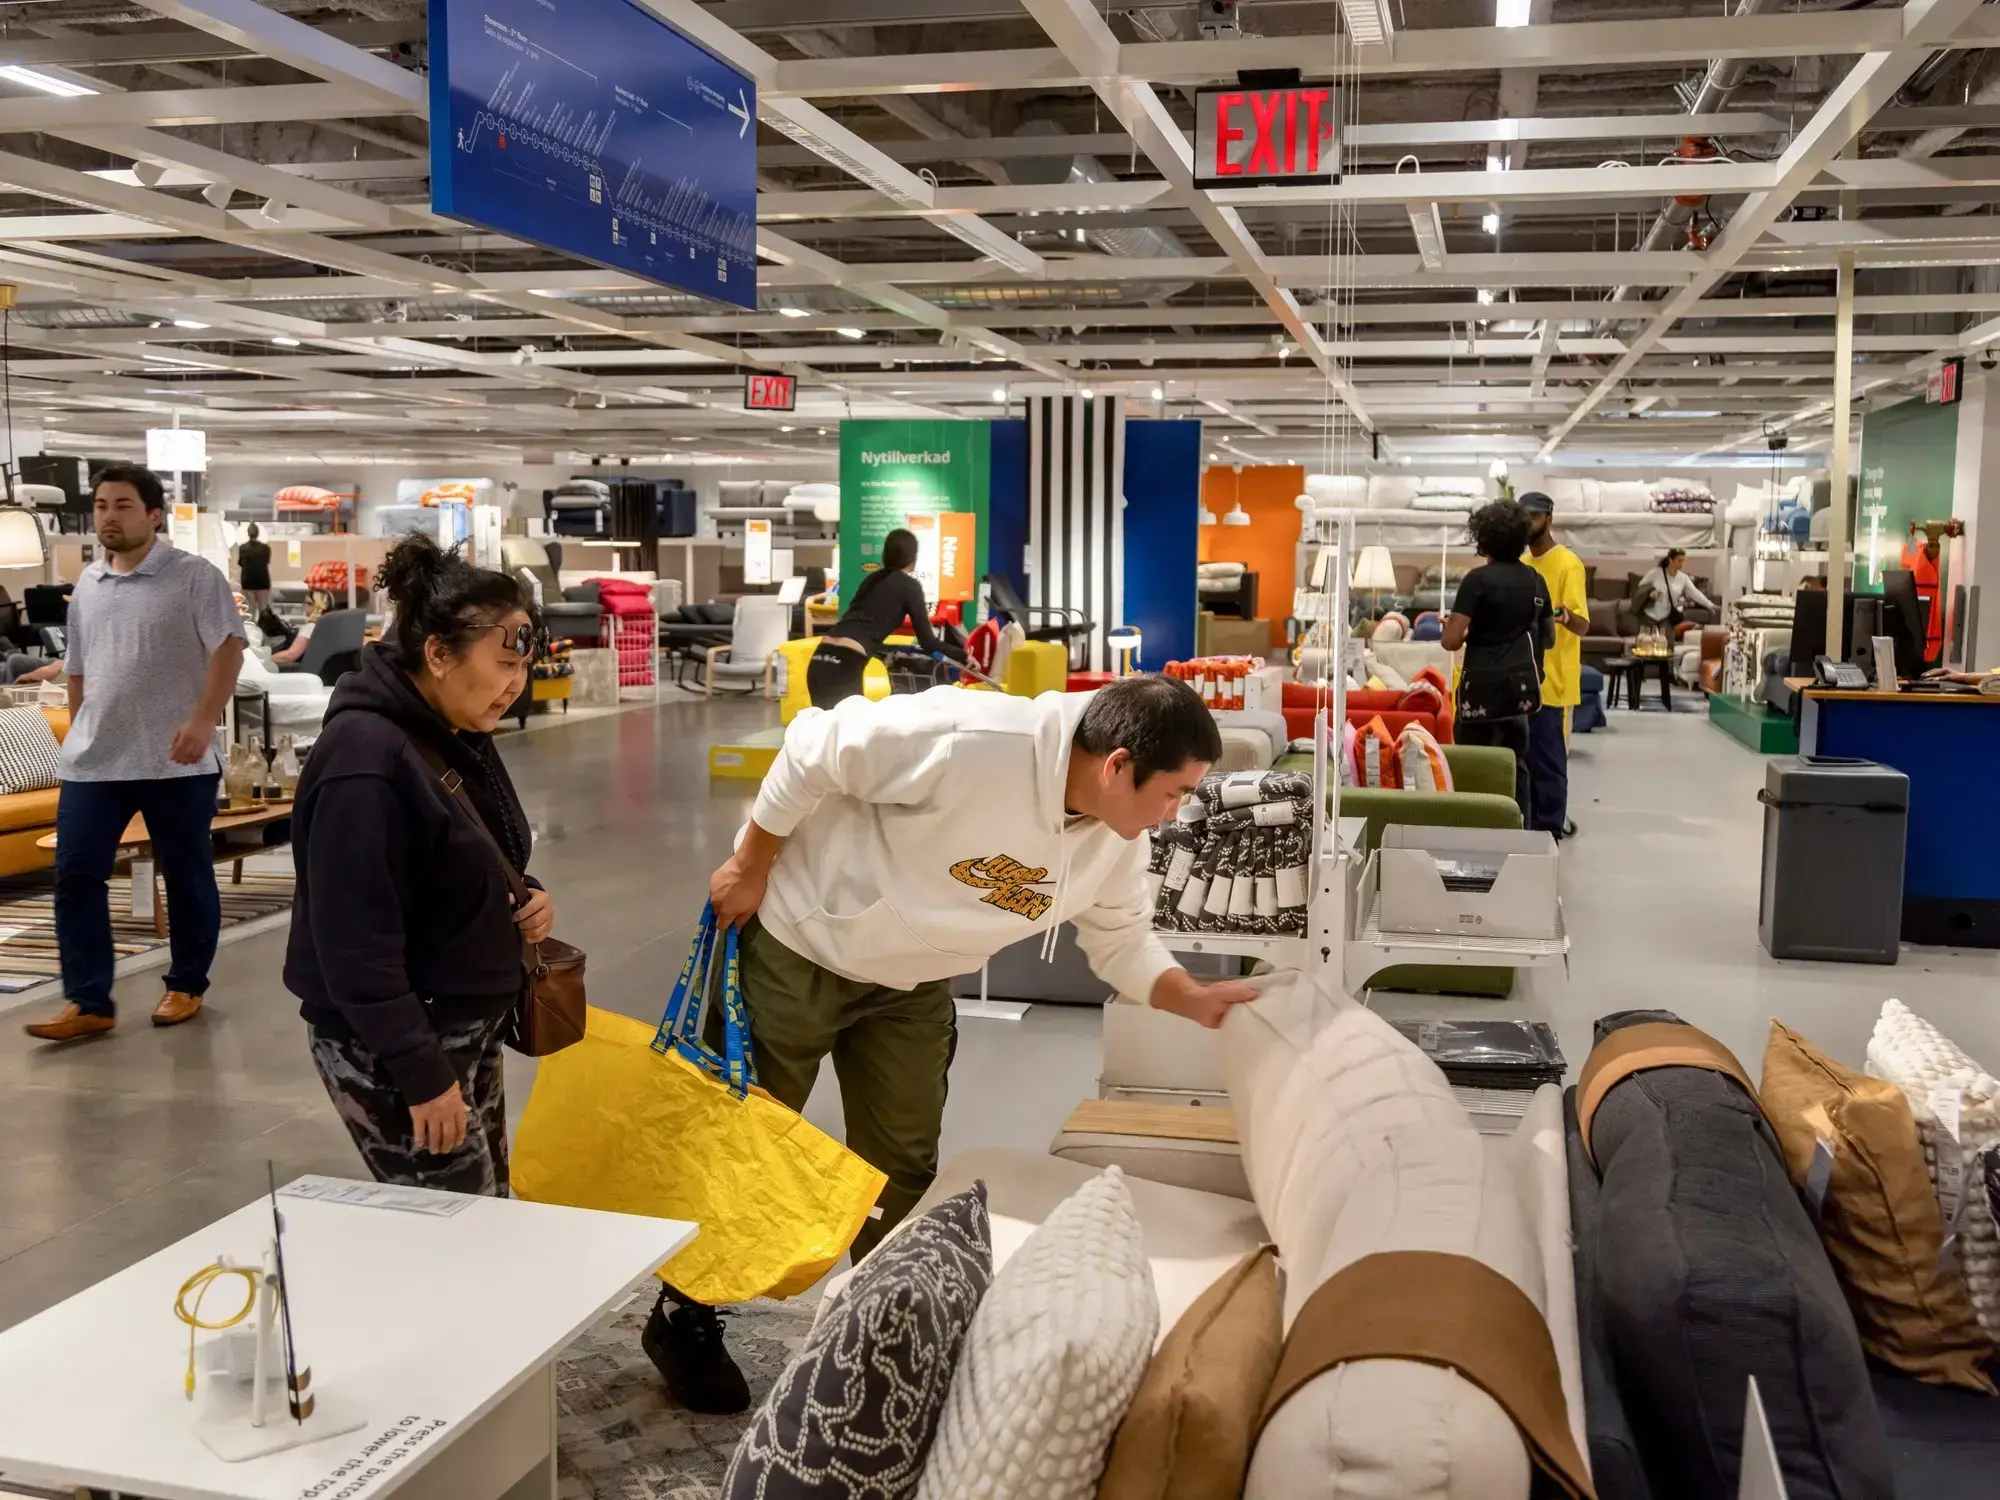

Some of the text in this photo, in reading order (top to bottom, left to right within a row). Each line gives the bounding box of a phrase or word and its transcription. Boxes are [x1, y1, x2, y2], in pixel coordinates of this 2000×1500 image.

[1216, 90, 1329, 175] EXIT
[752, 376, 789, 408] EXIT
[1941, 364, 1956, 400] EXIT
[861, 451, 951, 467] Nytillverkad
[942, 536, 958, 577] New
[725, 958, 739, 1024] IKEA
[399, 1415, 421, 1426] to
[403, 1419, 448, 1446] Press
[360, 1428, 408, 1458] lower
[377, 1448, 409, 1466] the
[331, 1458, 364, 1477] the
